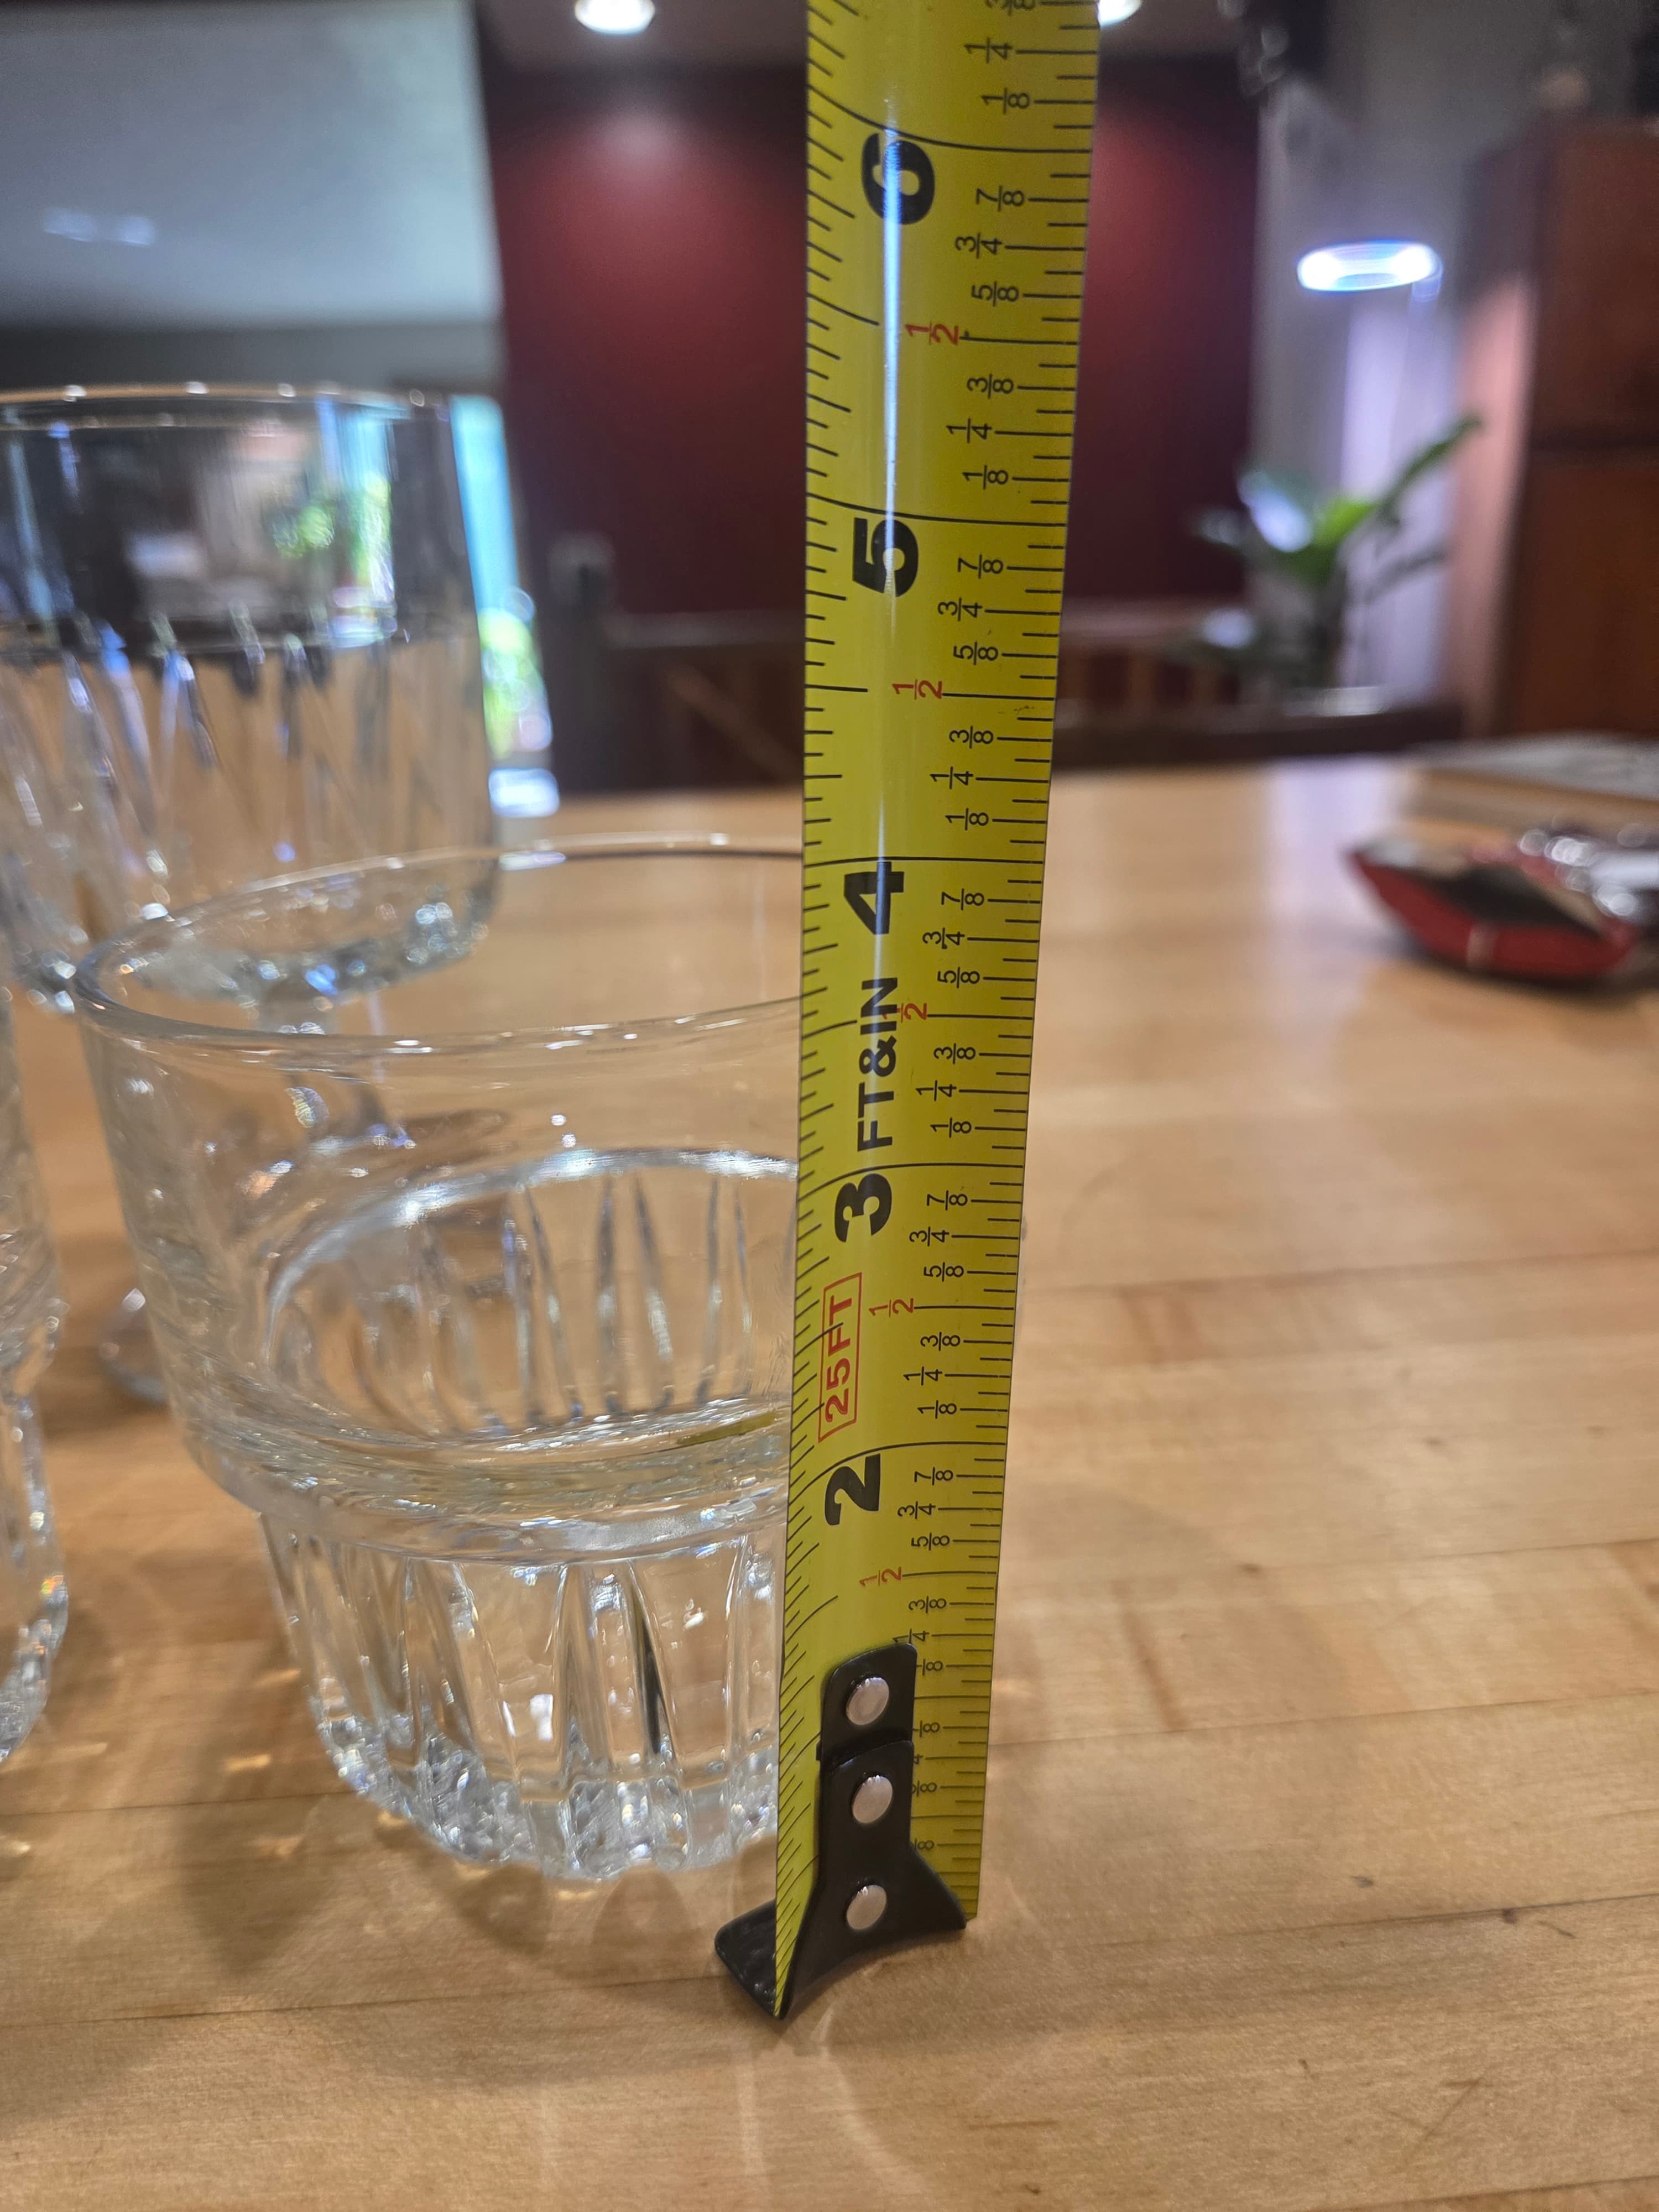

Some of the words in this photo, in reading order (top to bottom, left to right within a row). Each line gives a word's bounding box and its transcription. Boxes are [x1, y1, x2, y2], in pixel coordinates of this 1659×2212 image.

[862, 133, 935, 225] 6
[852, 517, 919, 598] 5
[844, 862, 904, 935] 4
[834, 1173, 892, 1242] 3
[825, 1453, 881, 1526] 2
